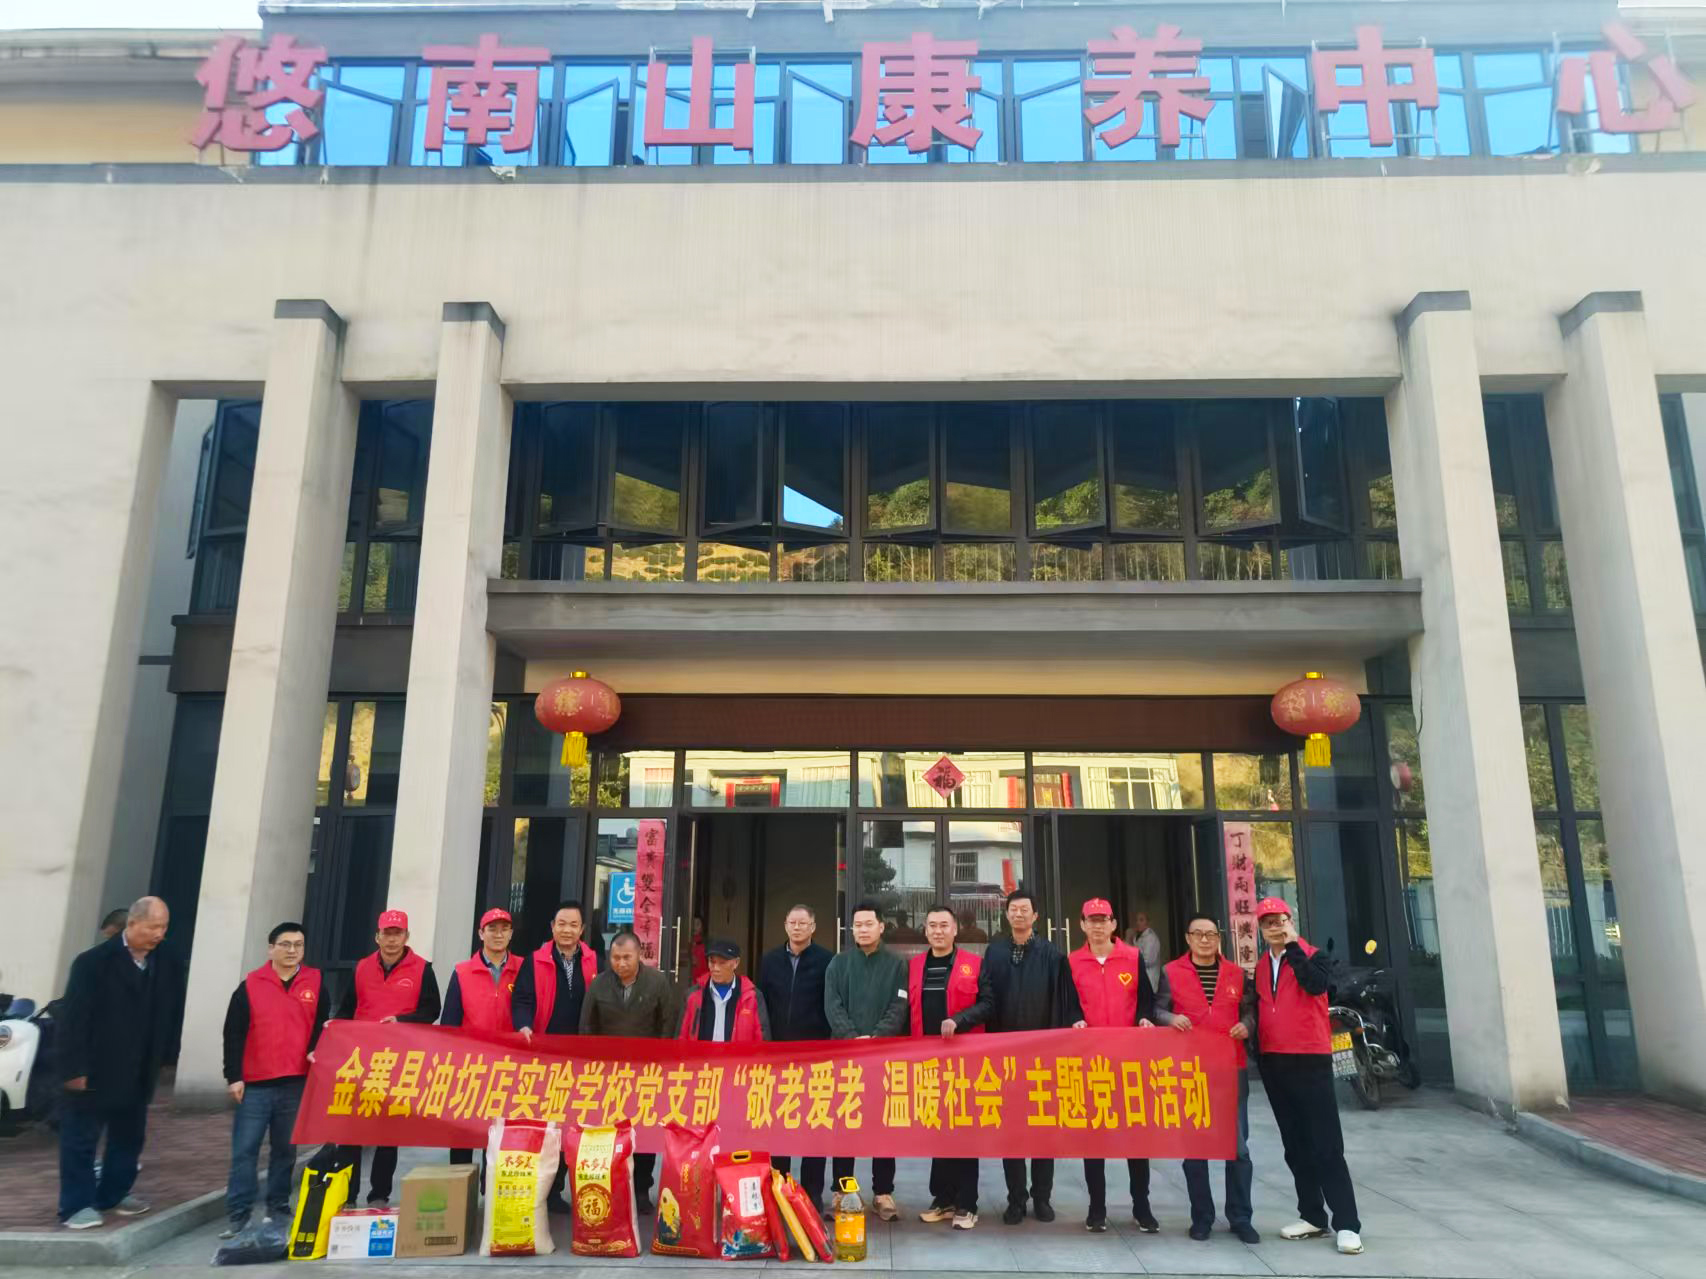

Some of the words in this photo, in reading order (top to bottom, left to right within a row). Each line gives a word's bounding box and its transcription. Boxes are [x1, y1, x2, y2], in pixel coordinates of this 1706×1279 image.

[191, 22, 1698, 153] 悠南山康养中心
[883, 1055, 1211, 1130] 温暖社会”主题党日活动
[584, 1198, 601, 1218] 福
